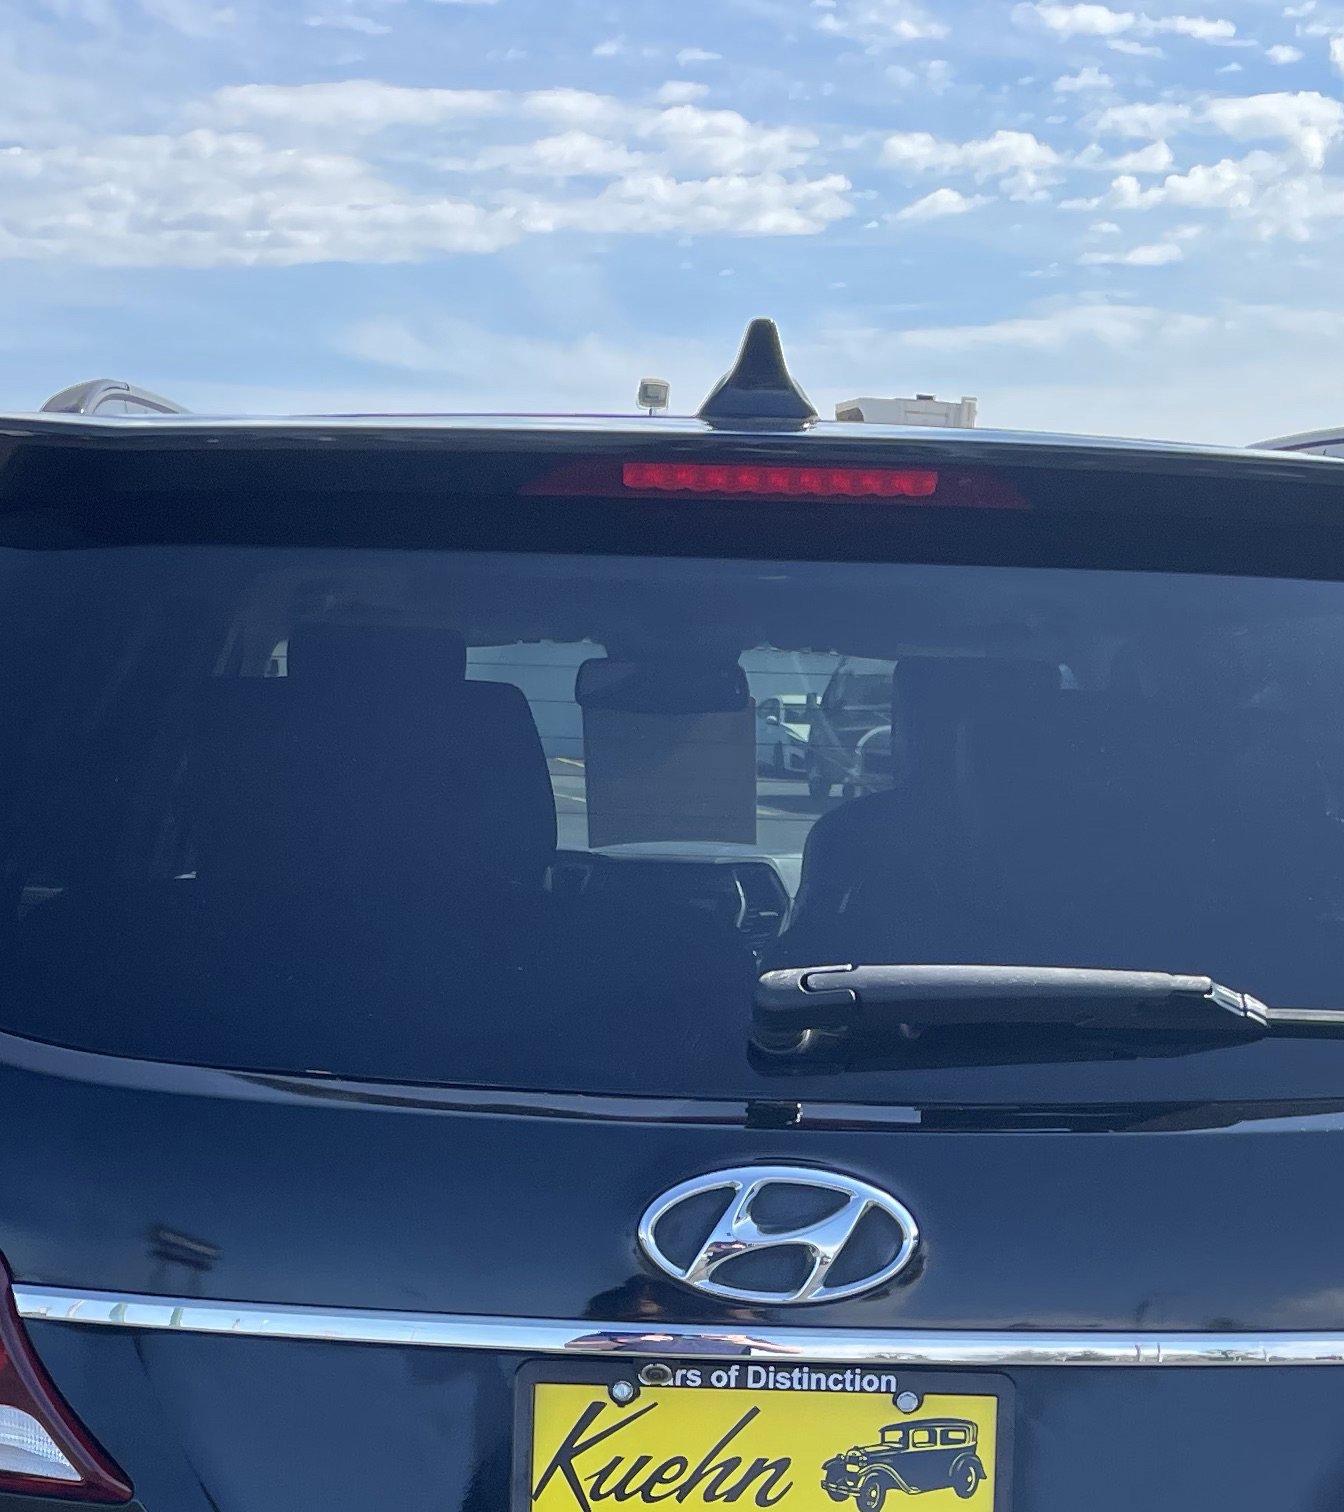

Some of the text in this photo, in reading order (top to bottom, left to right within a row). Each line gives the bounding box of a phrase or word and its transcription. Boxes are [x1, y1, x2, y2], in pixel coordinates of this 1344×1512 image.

[637, 1363, 897, 1393] rs of Distinction
